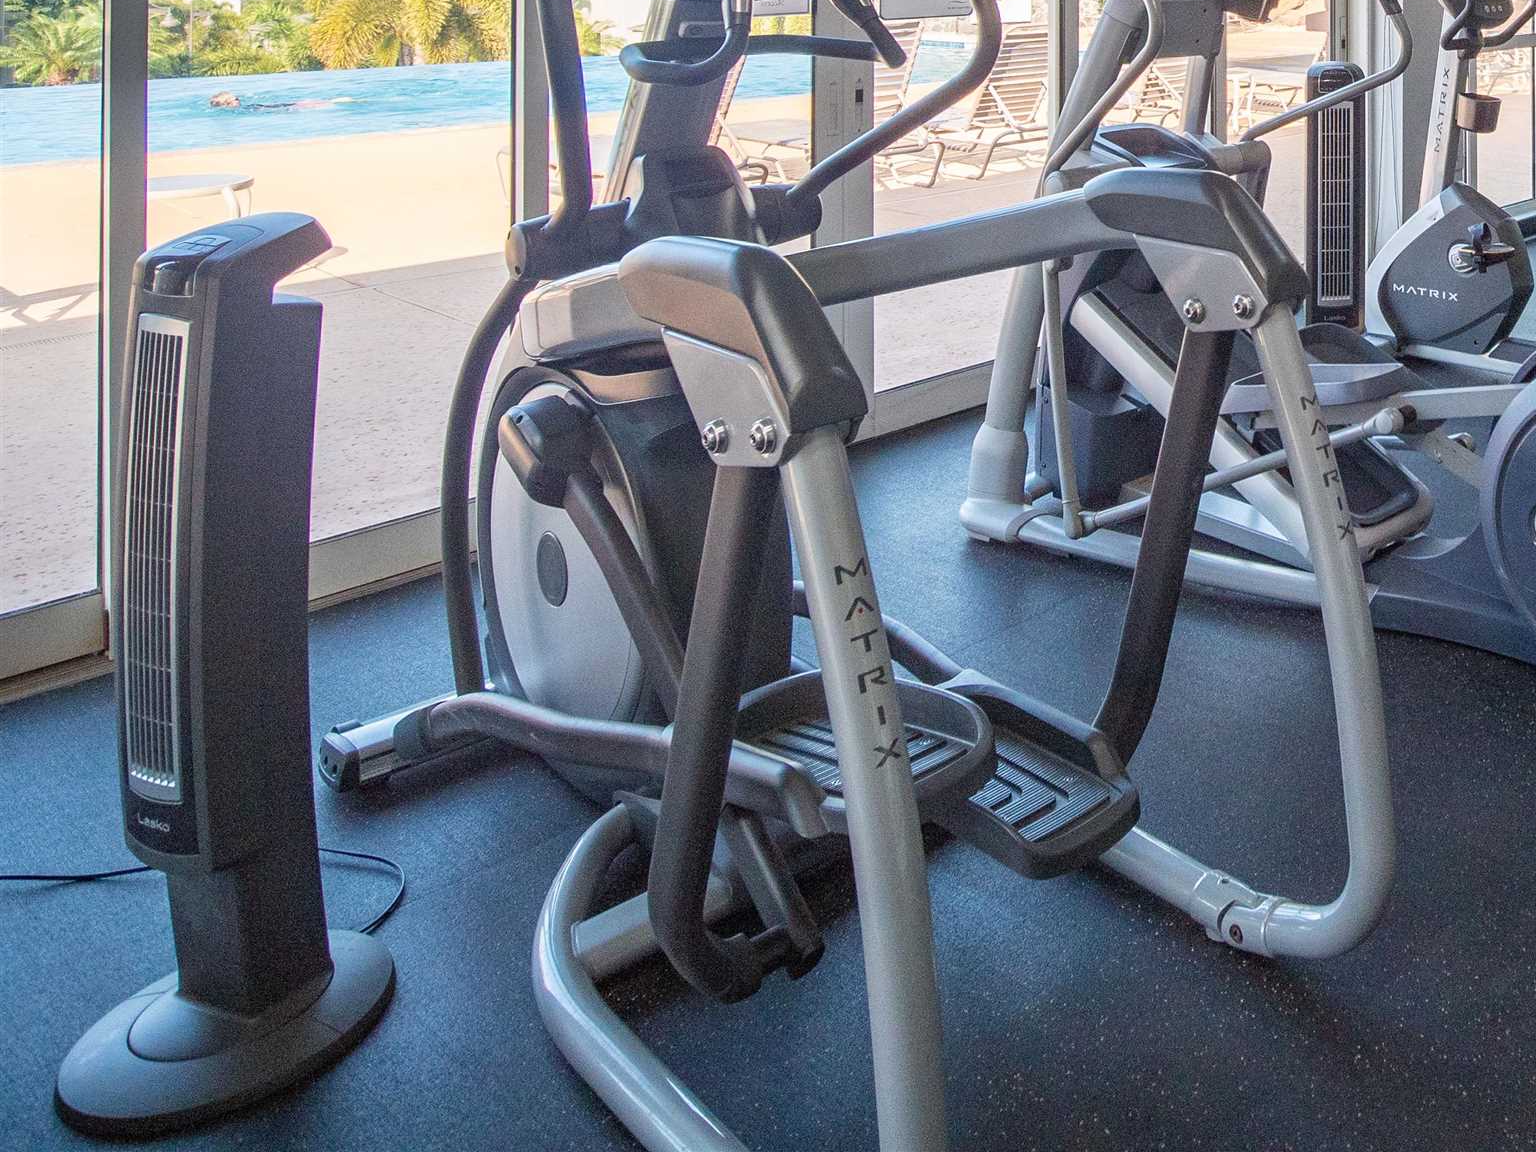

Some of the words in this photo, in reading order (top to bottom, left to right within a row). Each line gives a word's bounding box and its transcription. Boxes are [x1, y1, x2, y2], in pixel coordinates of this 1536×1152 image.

[1434, 68, 1450, 152] MATRIX
[1393, 283, 1459, 302] MATRIX
[1300, 396, 1353, 540] MATRIX
[834, 557, 901, 769] MATRIX
[137, 812, 170, 833] Lasko
